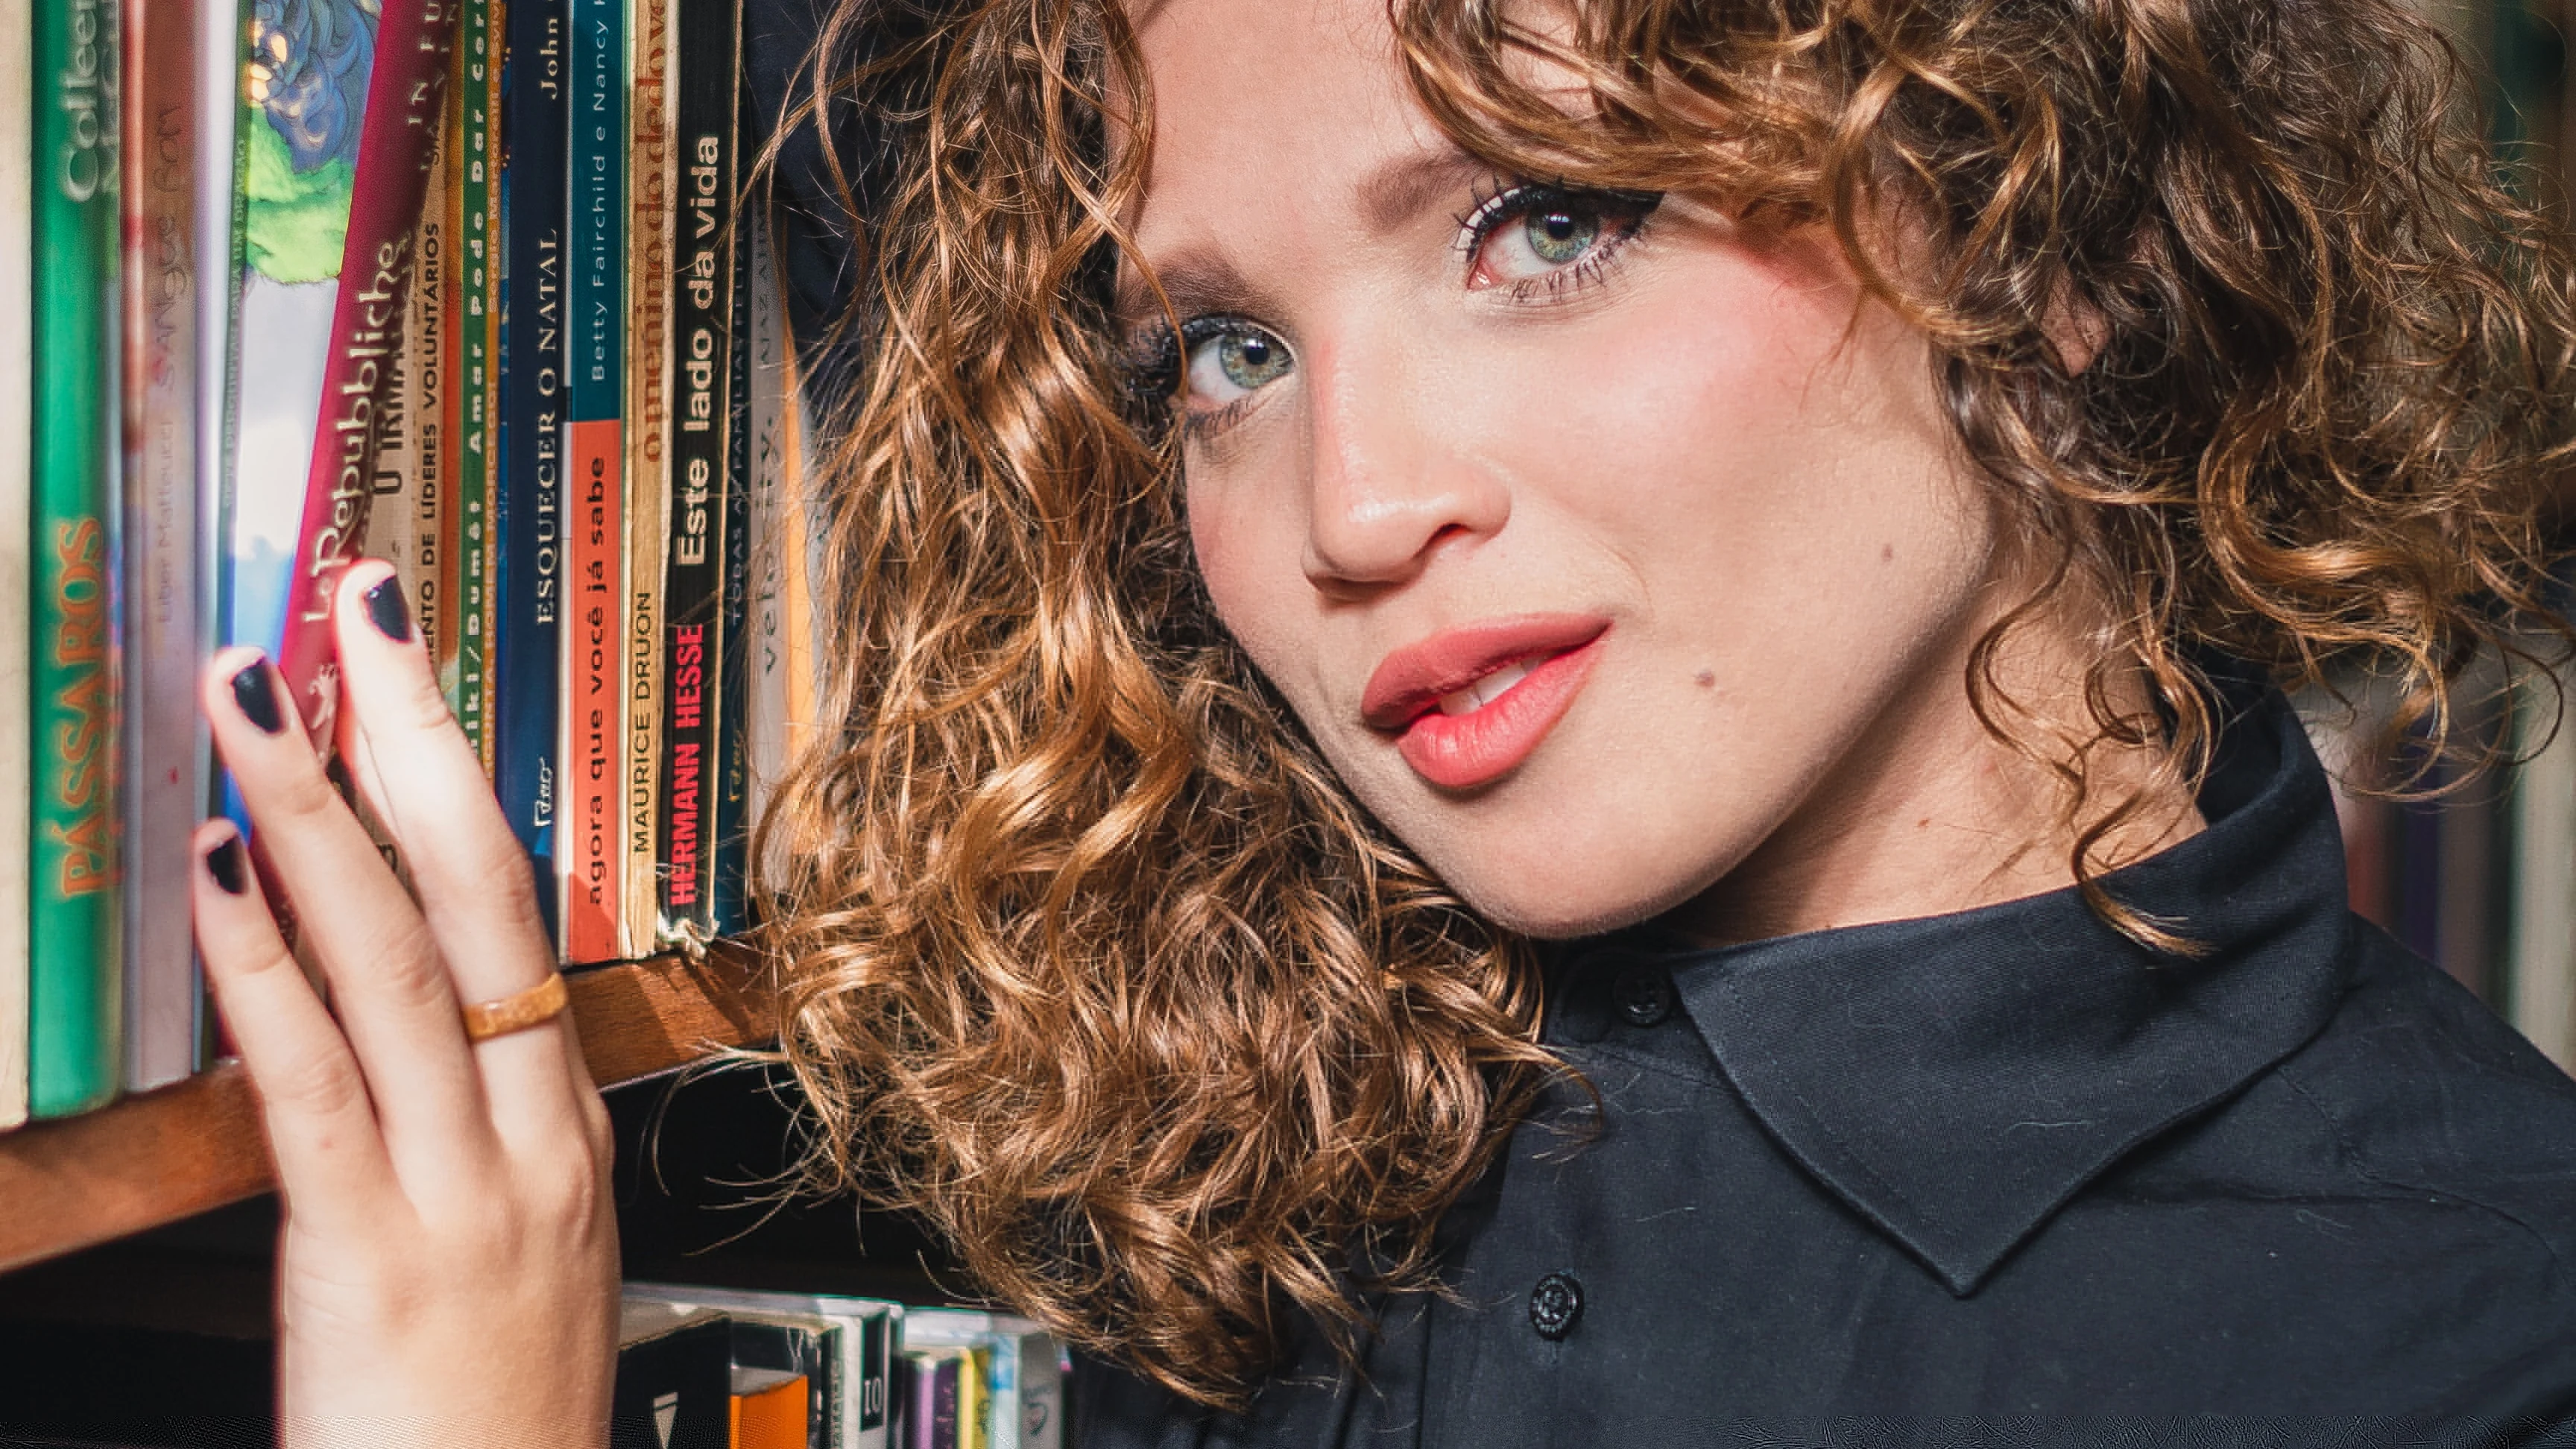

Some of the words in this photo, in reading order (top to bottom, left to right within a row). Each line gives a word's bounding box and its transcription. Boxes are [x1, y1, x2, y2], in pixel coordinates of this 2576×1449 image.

[488, 0, 502, 60] Sylvi
[540, 16, 559, 100] John
[593, 19, 609, 112] Nancy
[471, 108, 484, 183] Dar
[596, 127, 606, 142] e
[635, 49, 665, 164] dedo
[592, 155, 606, 287] Fairchild
[635, 171, 663, 233] do
[690, 135, 719, 239] vida
[470, 211, 484, 315] Pode
[538, 228, 558, 352] NATAL
[688, 250, 716, 309] da
[420, 223, 439, 409] VOLUNTÁRIOS
[591, 301, 607, 381] Betty
[636, 242, 663, 426] menino
[311, 242, 399, 575] Repubbliche
[469, 343, 483, 453] Amar
[537, 367, 557, 397] O
[683, 328, 713, 432] lado
[419, 423, 437, 519] LÍDERES
[645, 432, 662, 463] o
[421, 533, 436, 566] DE
[536, 410, 559, 625] ESQUECER
[587, 456, 604, 546] sabe
[675, 458, 710, 565] Este
[587, 560, 607, 593] já
[587, 606, 604, 695] você
[634, 592, 651, 701] DRUON
[674, 624, 704, 728] HESSE
[51, 517, 107, 894] PÁSSAROS
[590, 710, 607, 780] que
[633, 711, 651, 853] MAURICE
[670, 742, 700, 906] HERMANN
[590, 795, 606, 903] agora
